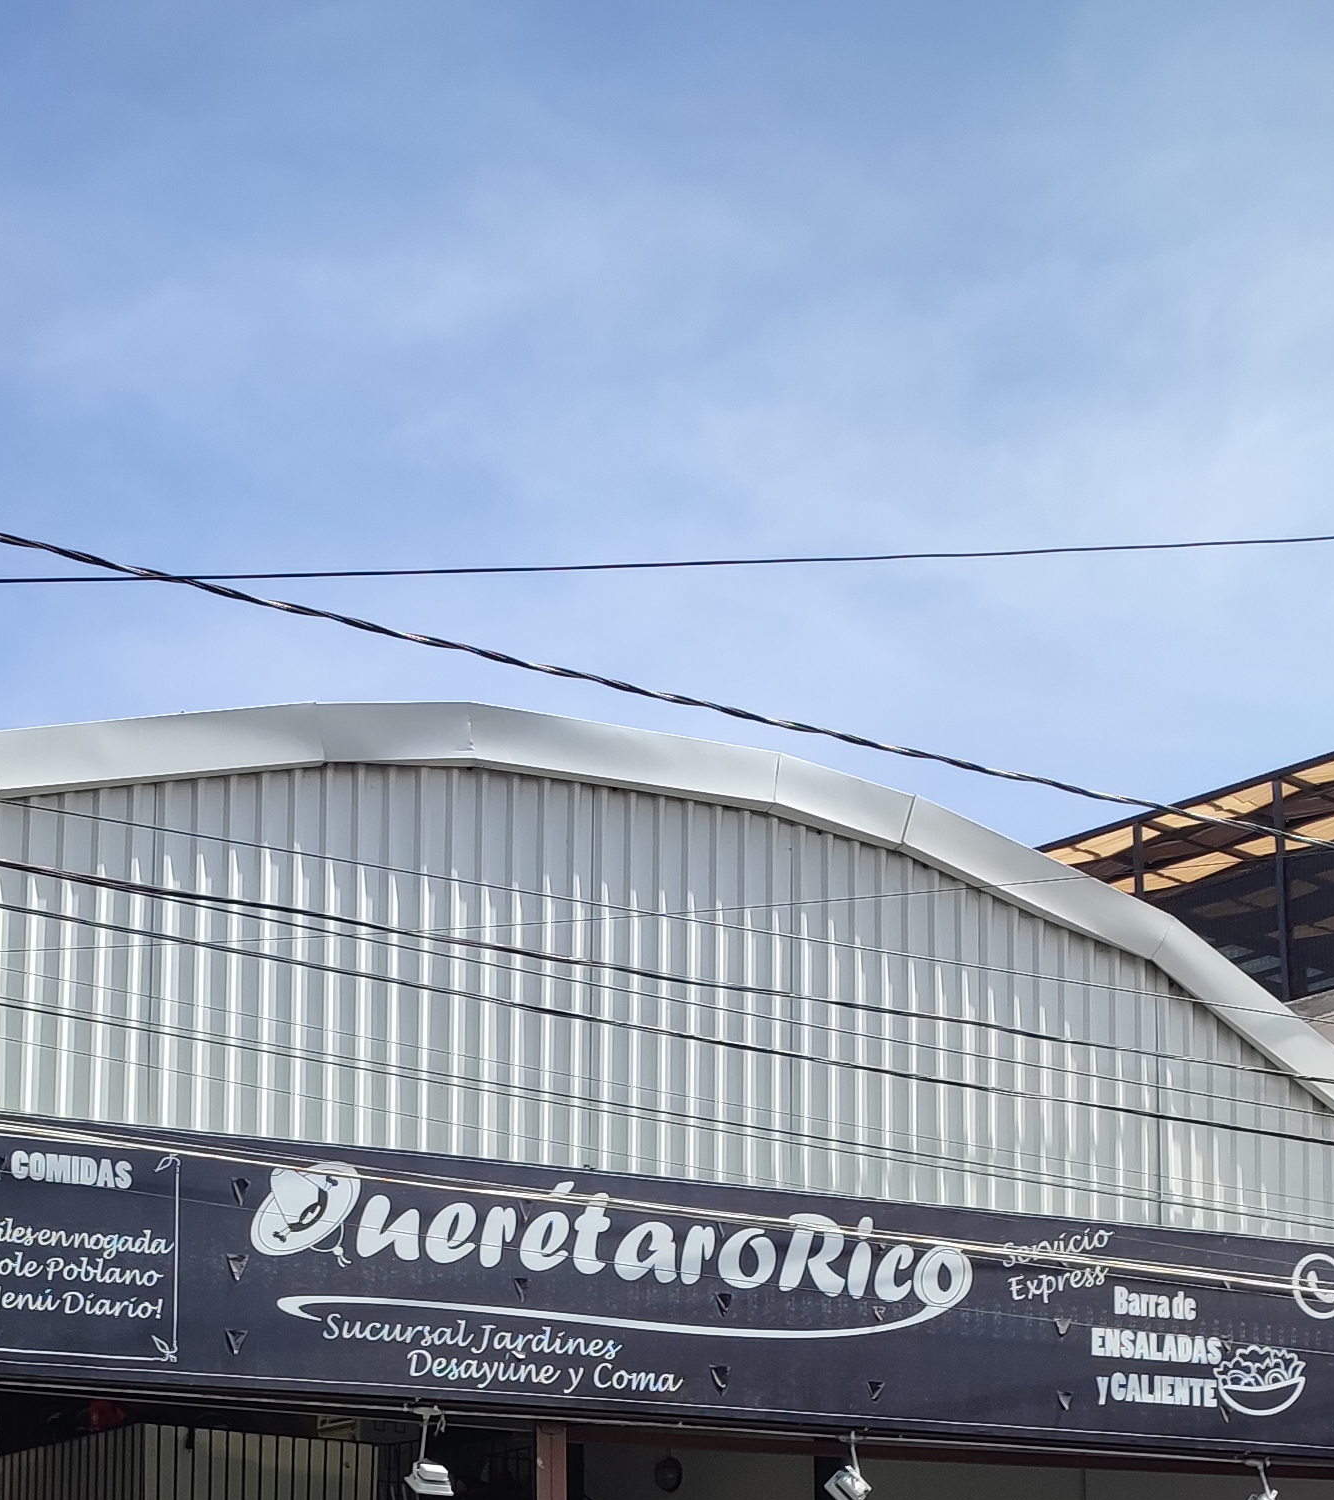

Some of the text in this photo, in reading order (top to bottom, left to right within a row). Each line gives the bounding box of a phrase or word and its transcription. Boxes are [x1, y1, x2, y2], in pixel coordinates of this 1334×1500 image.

[11, 1150, 133, 1189] COMIDAS
[1002, 1228, 1115, 1267] Servicio
[46, 1257, 164, 1287] Poblano
[1007, 1265, 1109, 1304] Express
[1113, 1285, 1197, 1320] Barra de
[322, 1313, 623, 1360] Sucursal Jardines
[1091, 1327, 1222, 1365] ENSALADAS
[563, 1366, 585, 1394] y
[593, 1363, 685, 1393] Coma
[1110, 1372, 1217, 1408] CALIENTE
